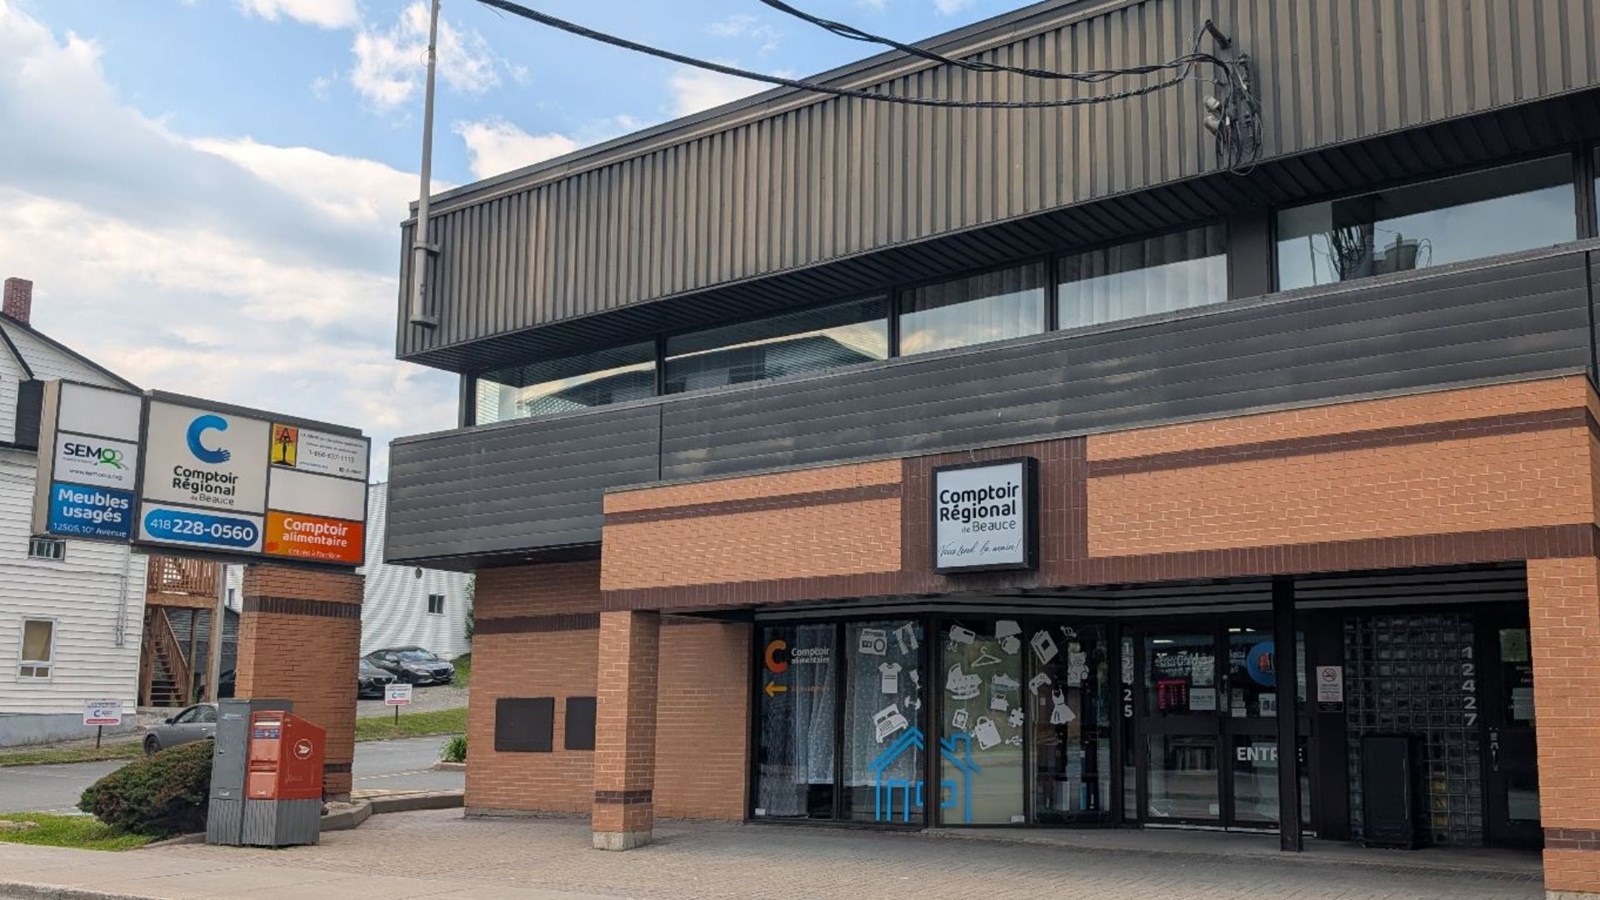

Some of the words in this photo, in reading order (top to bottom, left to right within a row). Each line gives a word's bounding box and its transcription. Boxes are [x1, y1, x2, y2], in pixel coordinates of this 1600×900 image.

[173, 465, 239, 485] Comptoir
[172, 477, 236, 496] Régional
[939, 481, 1019, 505] Comptoir
[58, 488, 129, 509] Meubles
[199, 493, 235, 506] Beauce
[62, 506, 122, 524] usagés
[939, 499, 1016, 523] Régional
[95, 527, 127, 537] Avenue
[150, 518, 172, 530] 418
[172, 518, 254, 541] 228-0560
[283, 517, 348, 536] Comptoir
[972, 520, 1016, 532] Beauce
[282, 532, 348, 547] alimentaire
[791, 646, 830, 657] Comptoir
[791, 656, 830, 665] alimentaire
[1236, 746, 1303, 761] ENTR
